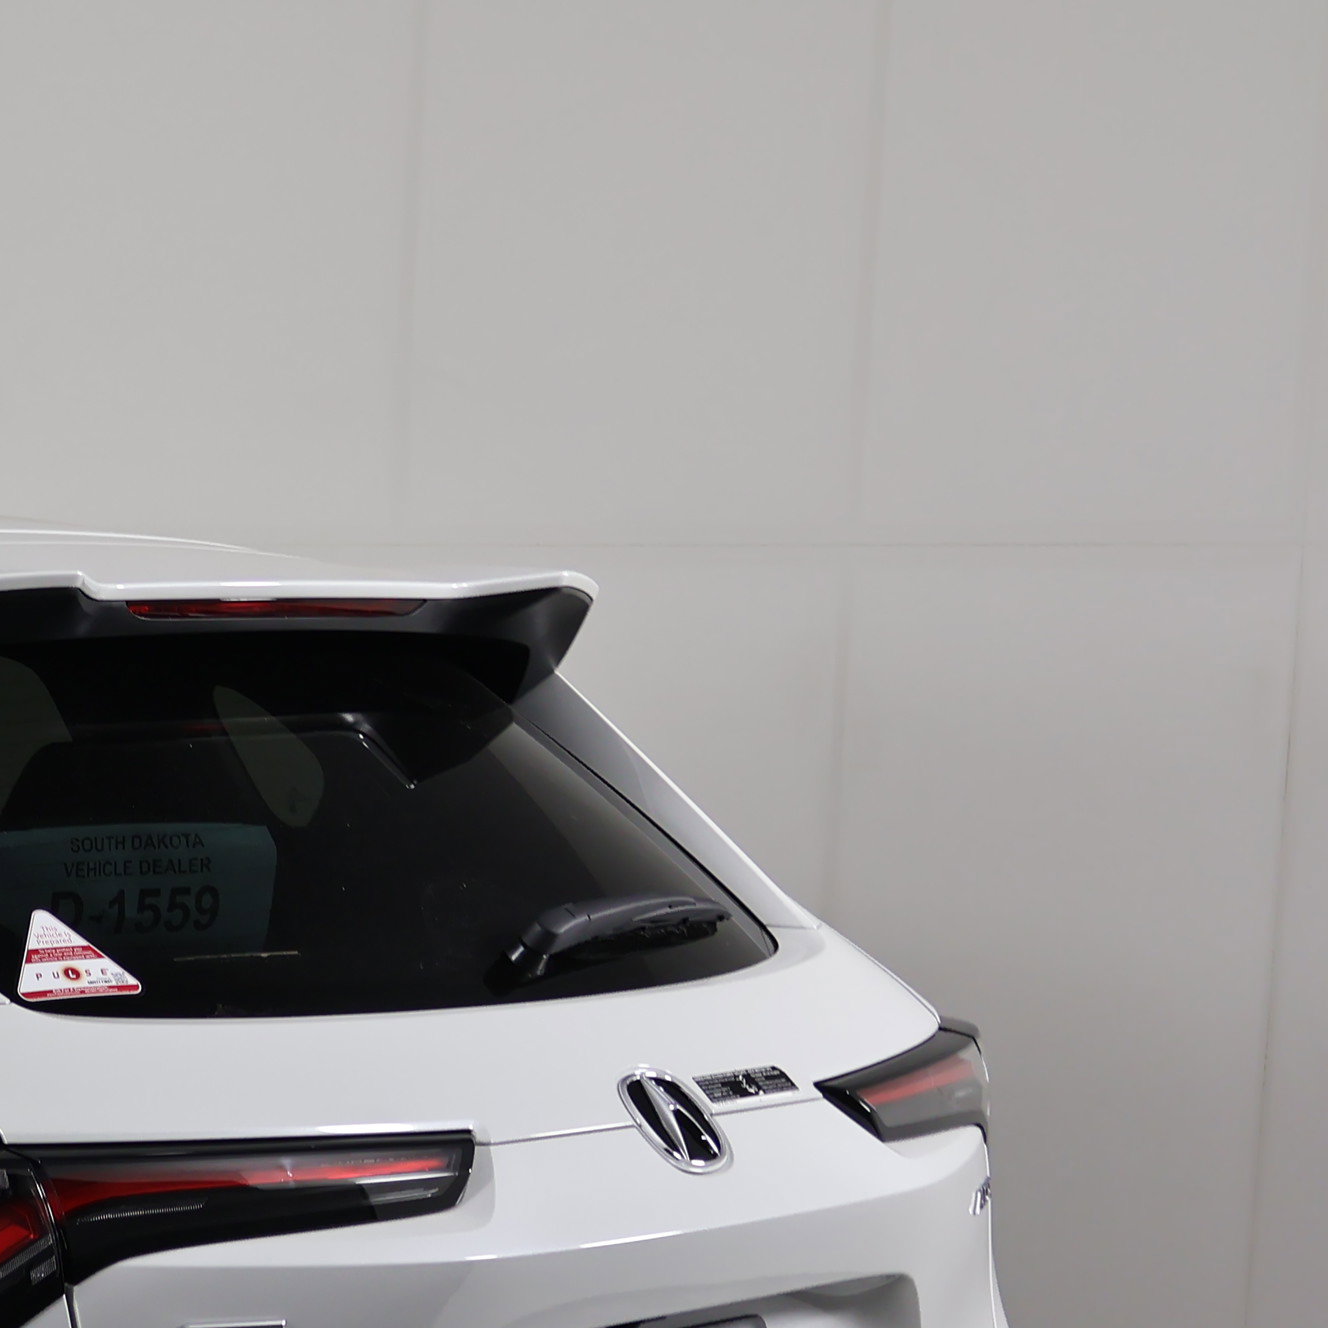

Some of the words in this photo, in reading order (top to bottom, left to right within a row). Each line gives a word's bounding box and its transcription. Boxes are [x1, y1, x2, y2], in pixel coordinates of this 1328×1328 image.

[70, 836, 126, 853] SOUTH
[131, 832, 205, 850] DAKOTA
[64, 860, 133, 878] VEHICLE
[139, 856, 212, 876] DEALER
[51, 884, 220, 935] D-1559
